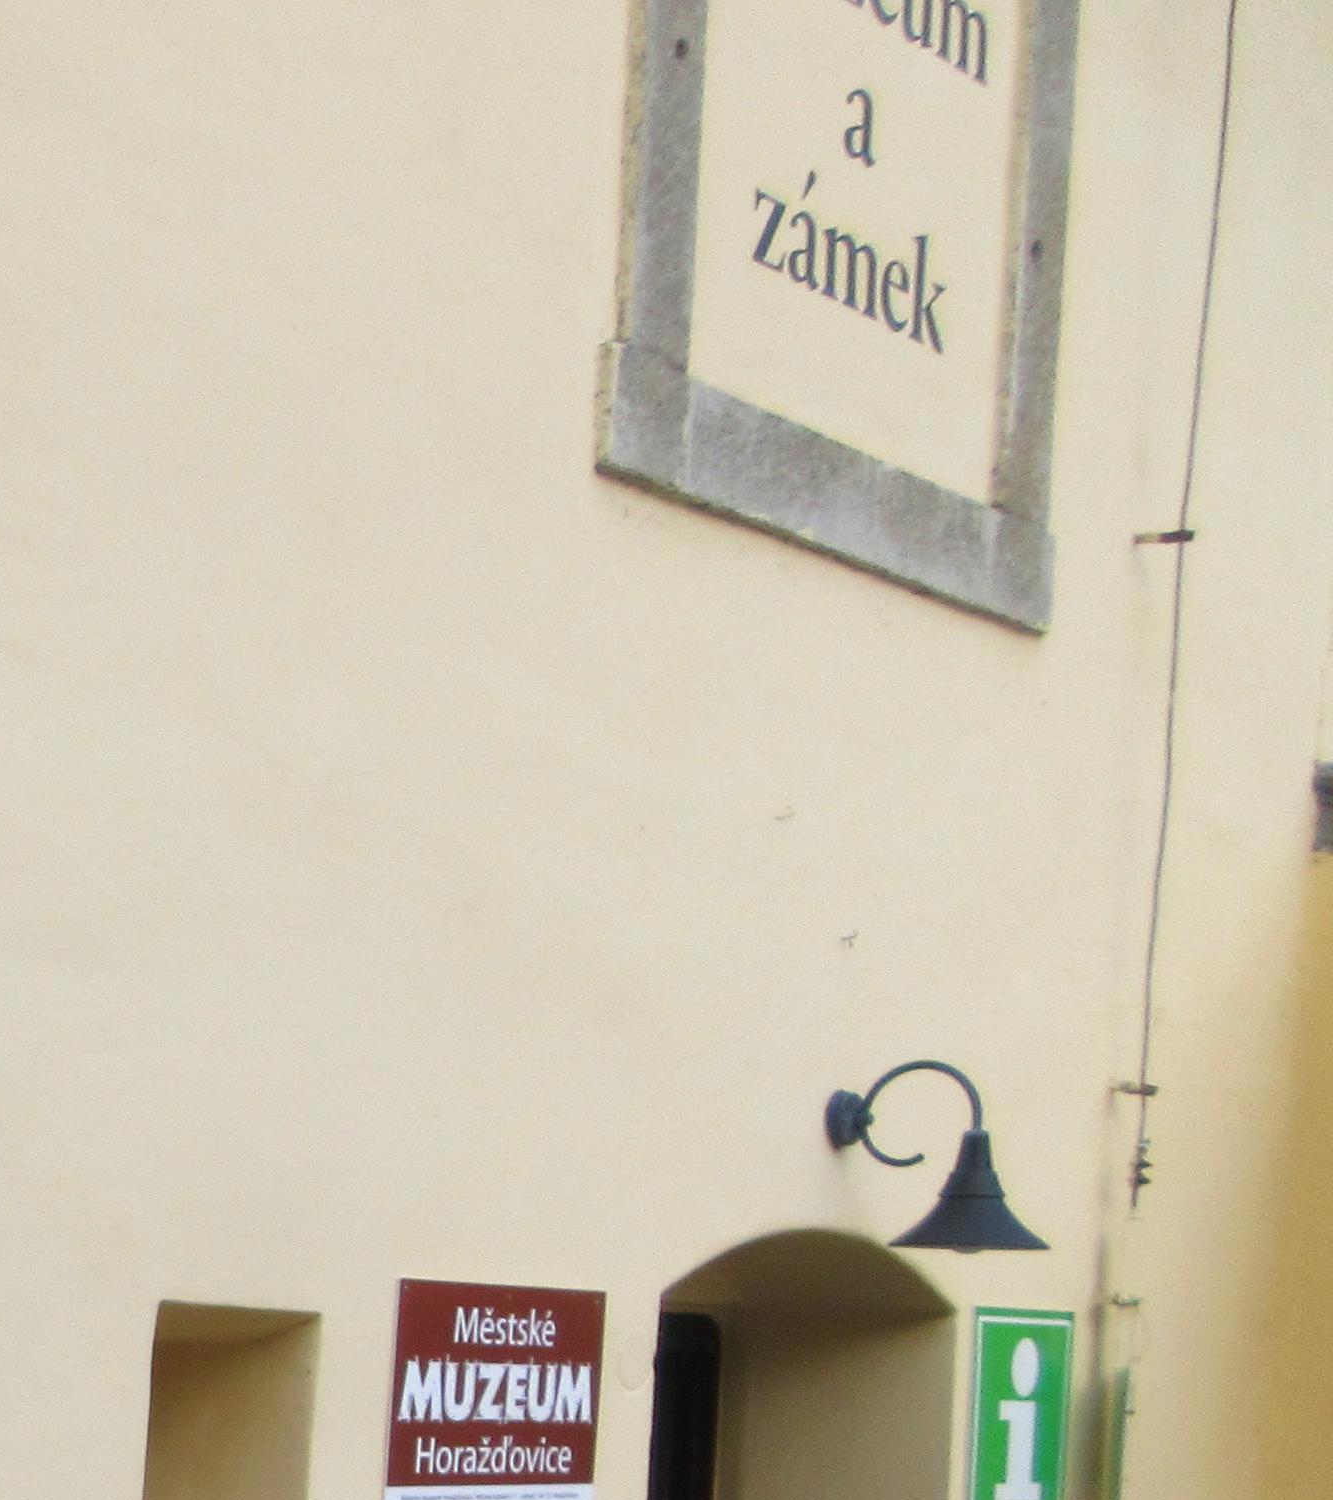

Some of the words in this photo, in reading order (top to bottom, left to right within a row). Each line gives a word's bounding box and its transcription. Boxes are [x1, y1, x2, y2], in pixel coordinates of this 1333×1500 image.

[844, 88, 875, 168] a
[753, 170, 947, 354] zámek
[454, 1306, 556, 1347] Městské
[398, 1358, 592, 1423] MUZEUM
[415, 1436, 572, 1474] Horažďovice
